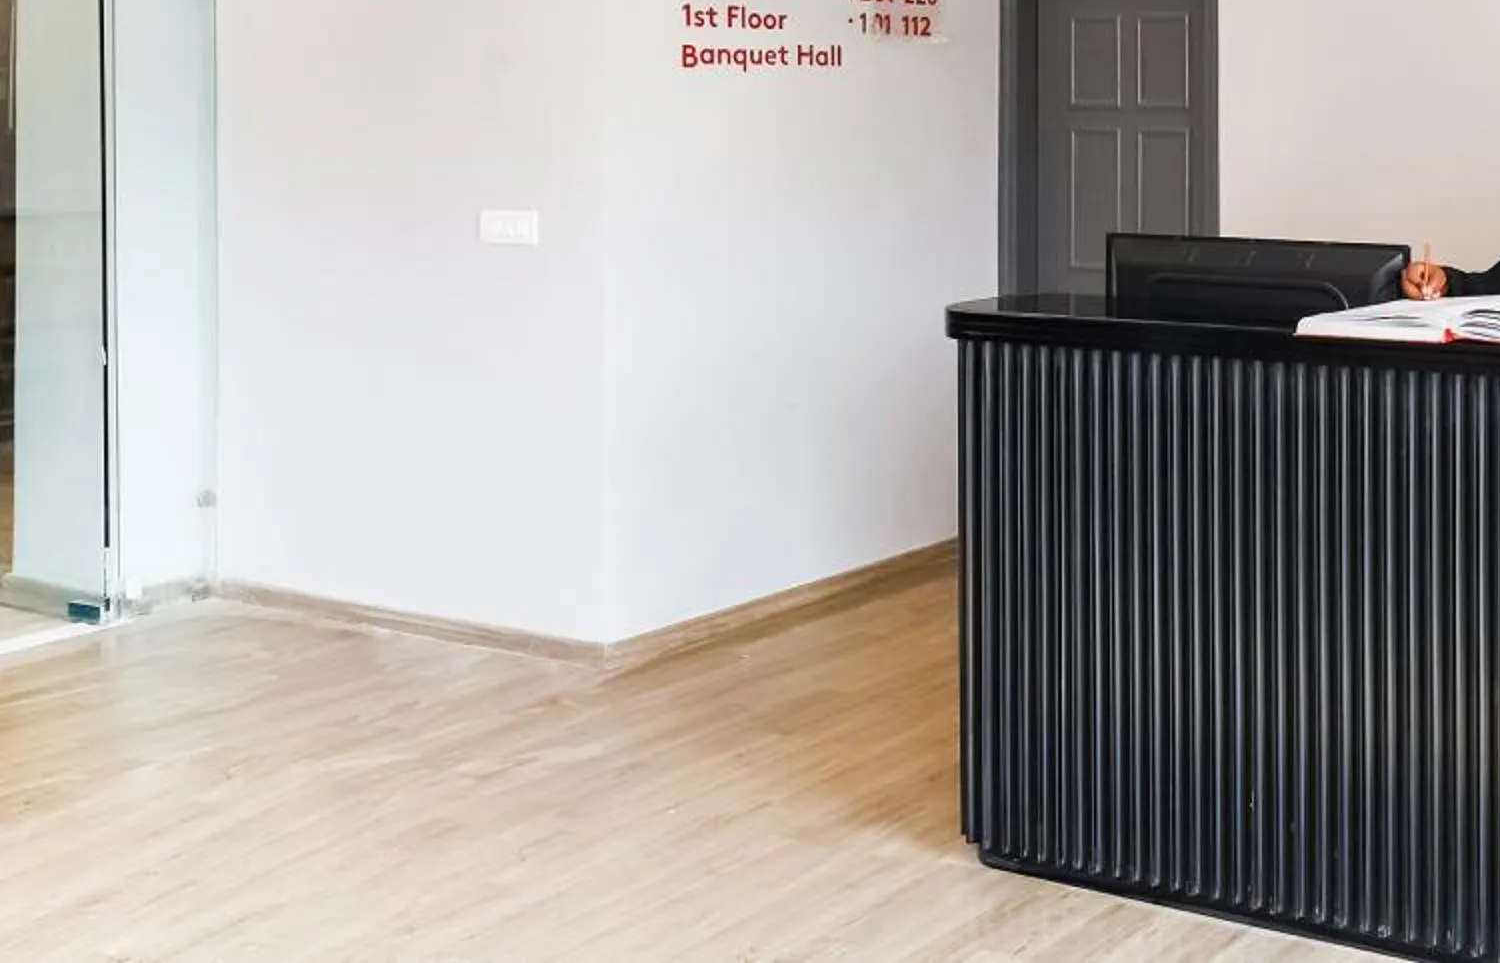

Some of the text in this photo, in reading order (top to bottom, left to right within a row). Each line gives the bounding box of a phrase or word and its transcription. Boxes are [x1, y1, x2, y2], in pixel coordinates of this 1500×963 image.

[681, 3, 718, 28] 1st
[727, 5, 788, 30] Floor
[681, 44, 842, 73] Banquet Hall
